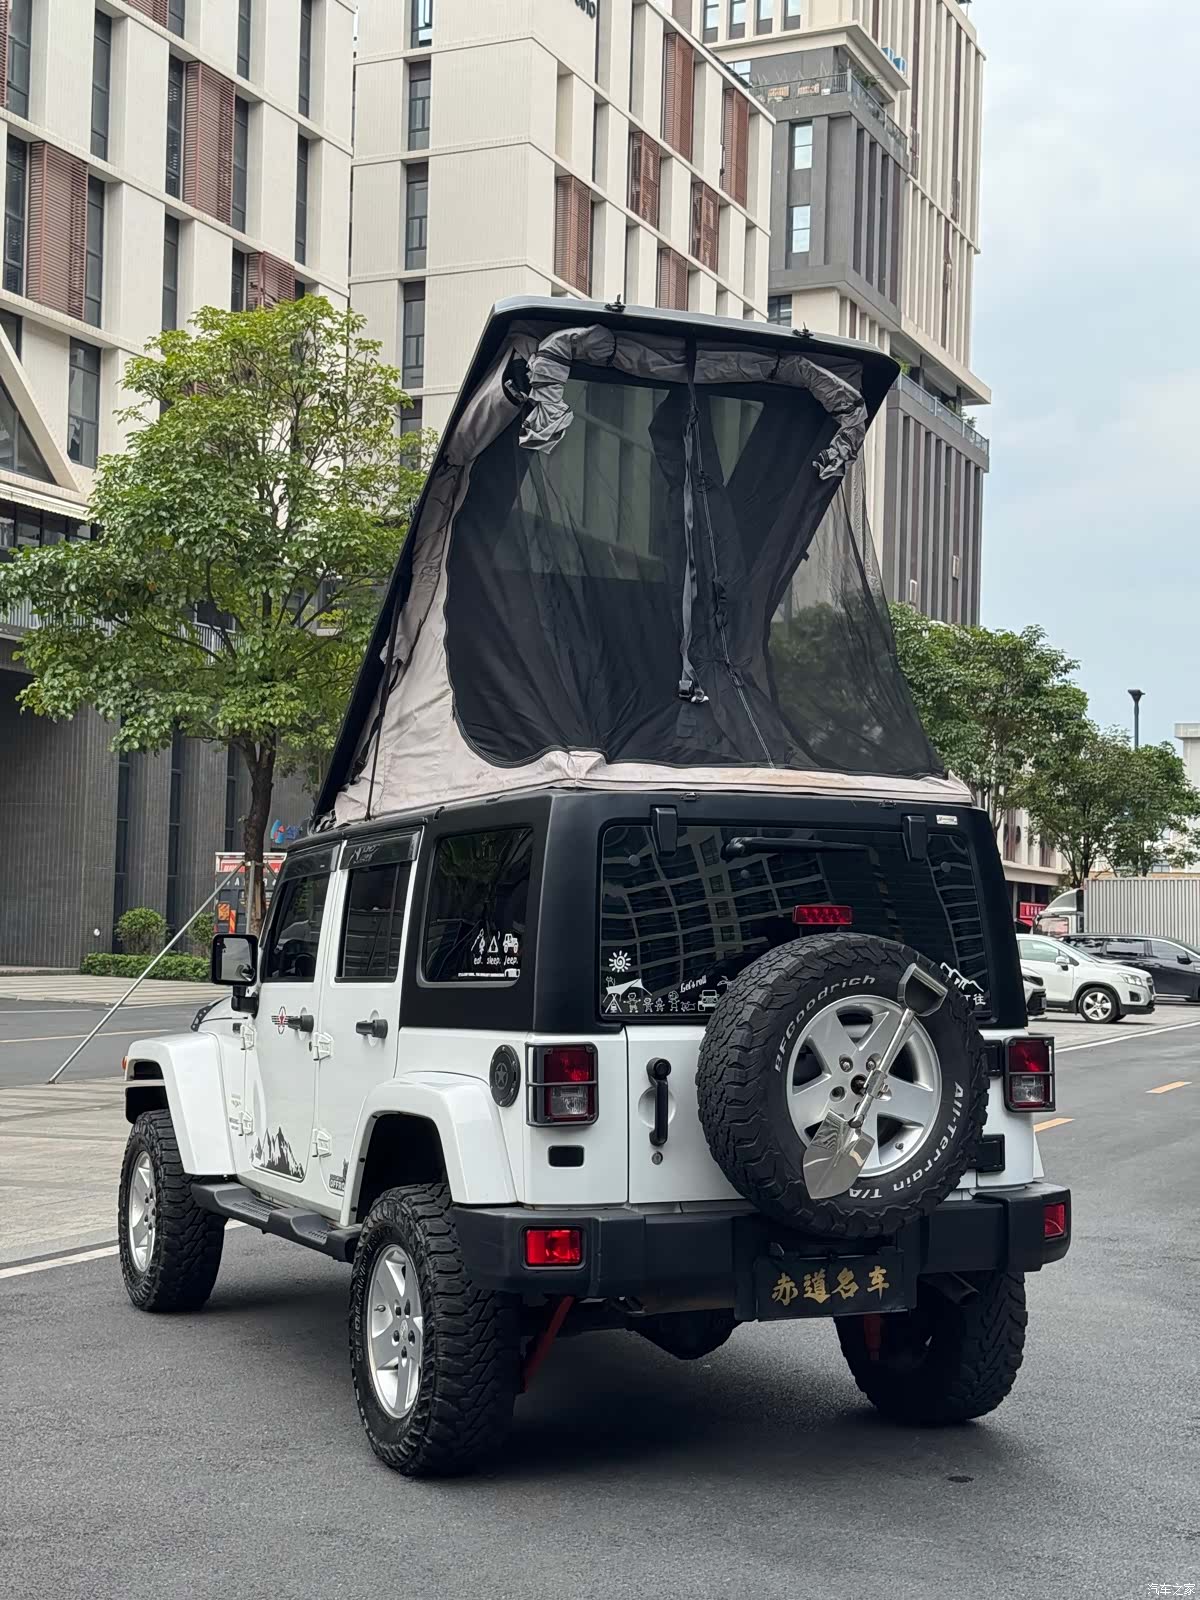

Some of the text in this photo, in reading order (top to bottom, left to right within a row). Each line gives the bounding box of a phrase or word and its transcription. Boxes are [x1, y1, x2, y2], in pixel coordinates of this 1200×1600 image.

[695, 974, 707, 987] roll
[774, 974, 882, 1073] BFGoodrich
[849, 1081, 964, 1199] All-Terrain T/A
[771, 1265, 890, 1306] 赤道名车
